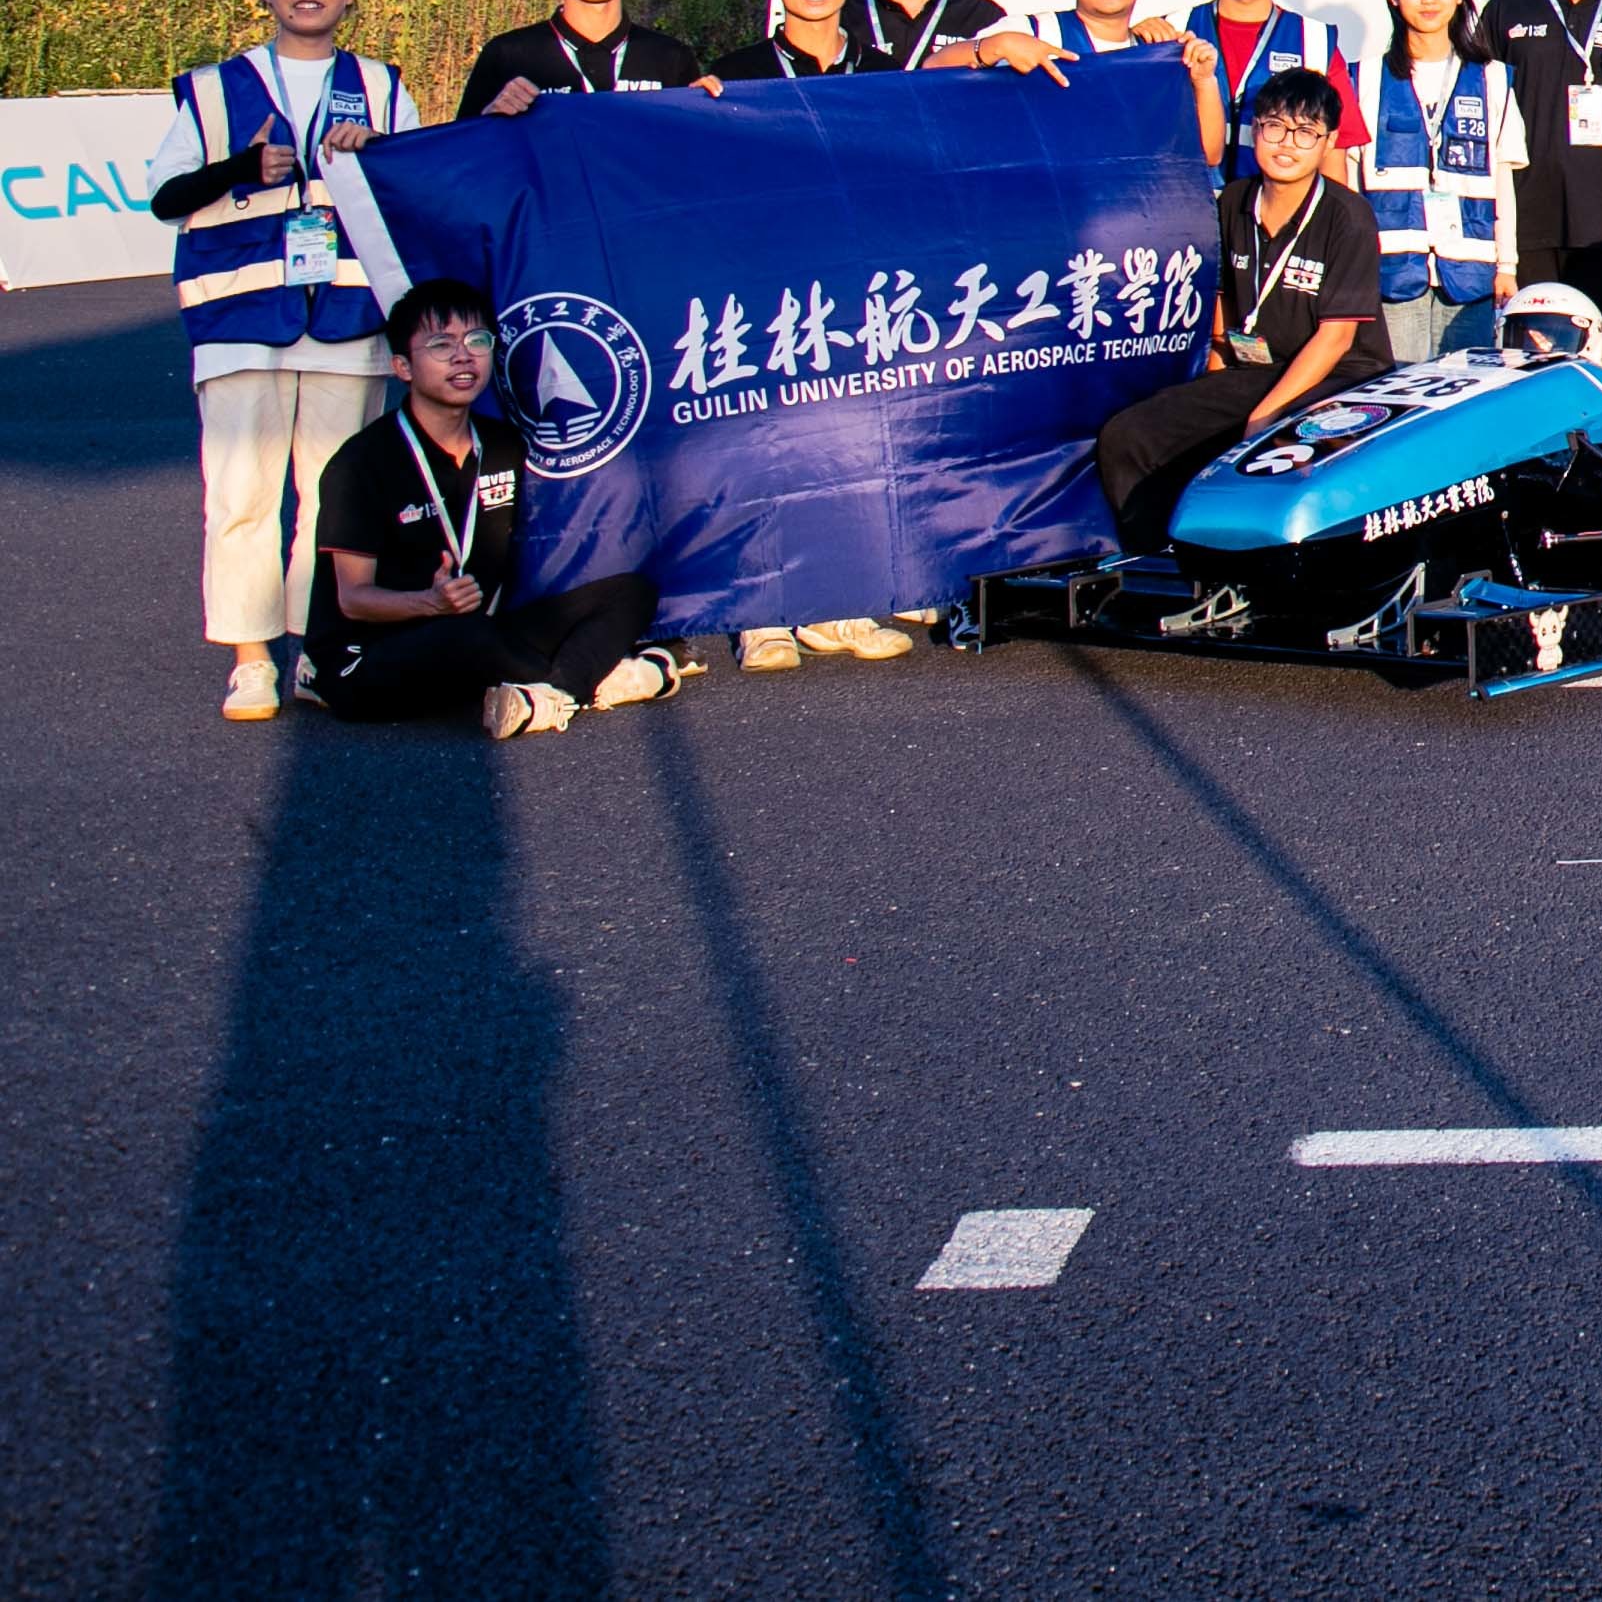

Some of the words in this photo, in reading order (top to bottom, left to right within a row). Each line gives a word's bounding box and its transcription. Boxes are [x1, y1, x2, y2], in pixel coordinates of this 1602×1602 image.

[1469, 119, 1485, 137] 28
[1, 159, 155, 220] CAL
[672, 388, 768, 424] GUILIN
[780, 361, 936, 406] UNIVERSITY
[945, 356, 976, 381] OF
[982, 342, 1096, 376] AEROSPACE
[1103, 331, 1196, 360] TECHNOLOGY
[1352, 373, 1481, 398] E28
[560, 436, 615, 468] AEROSPACE
[613, 368, 640, 436] TECHNOLOGY
